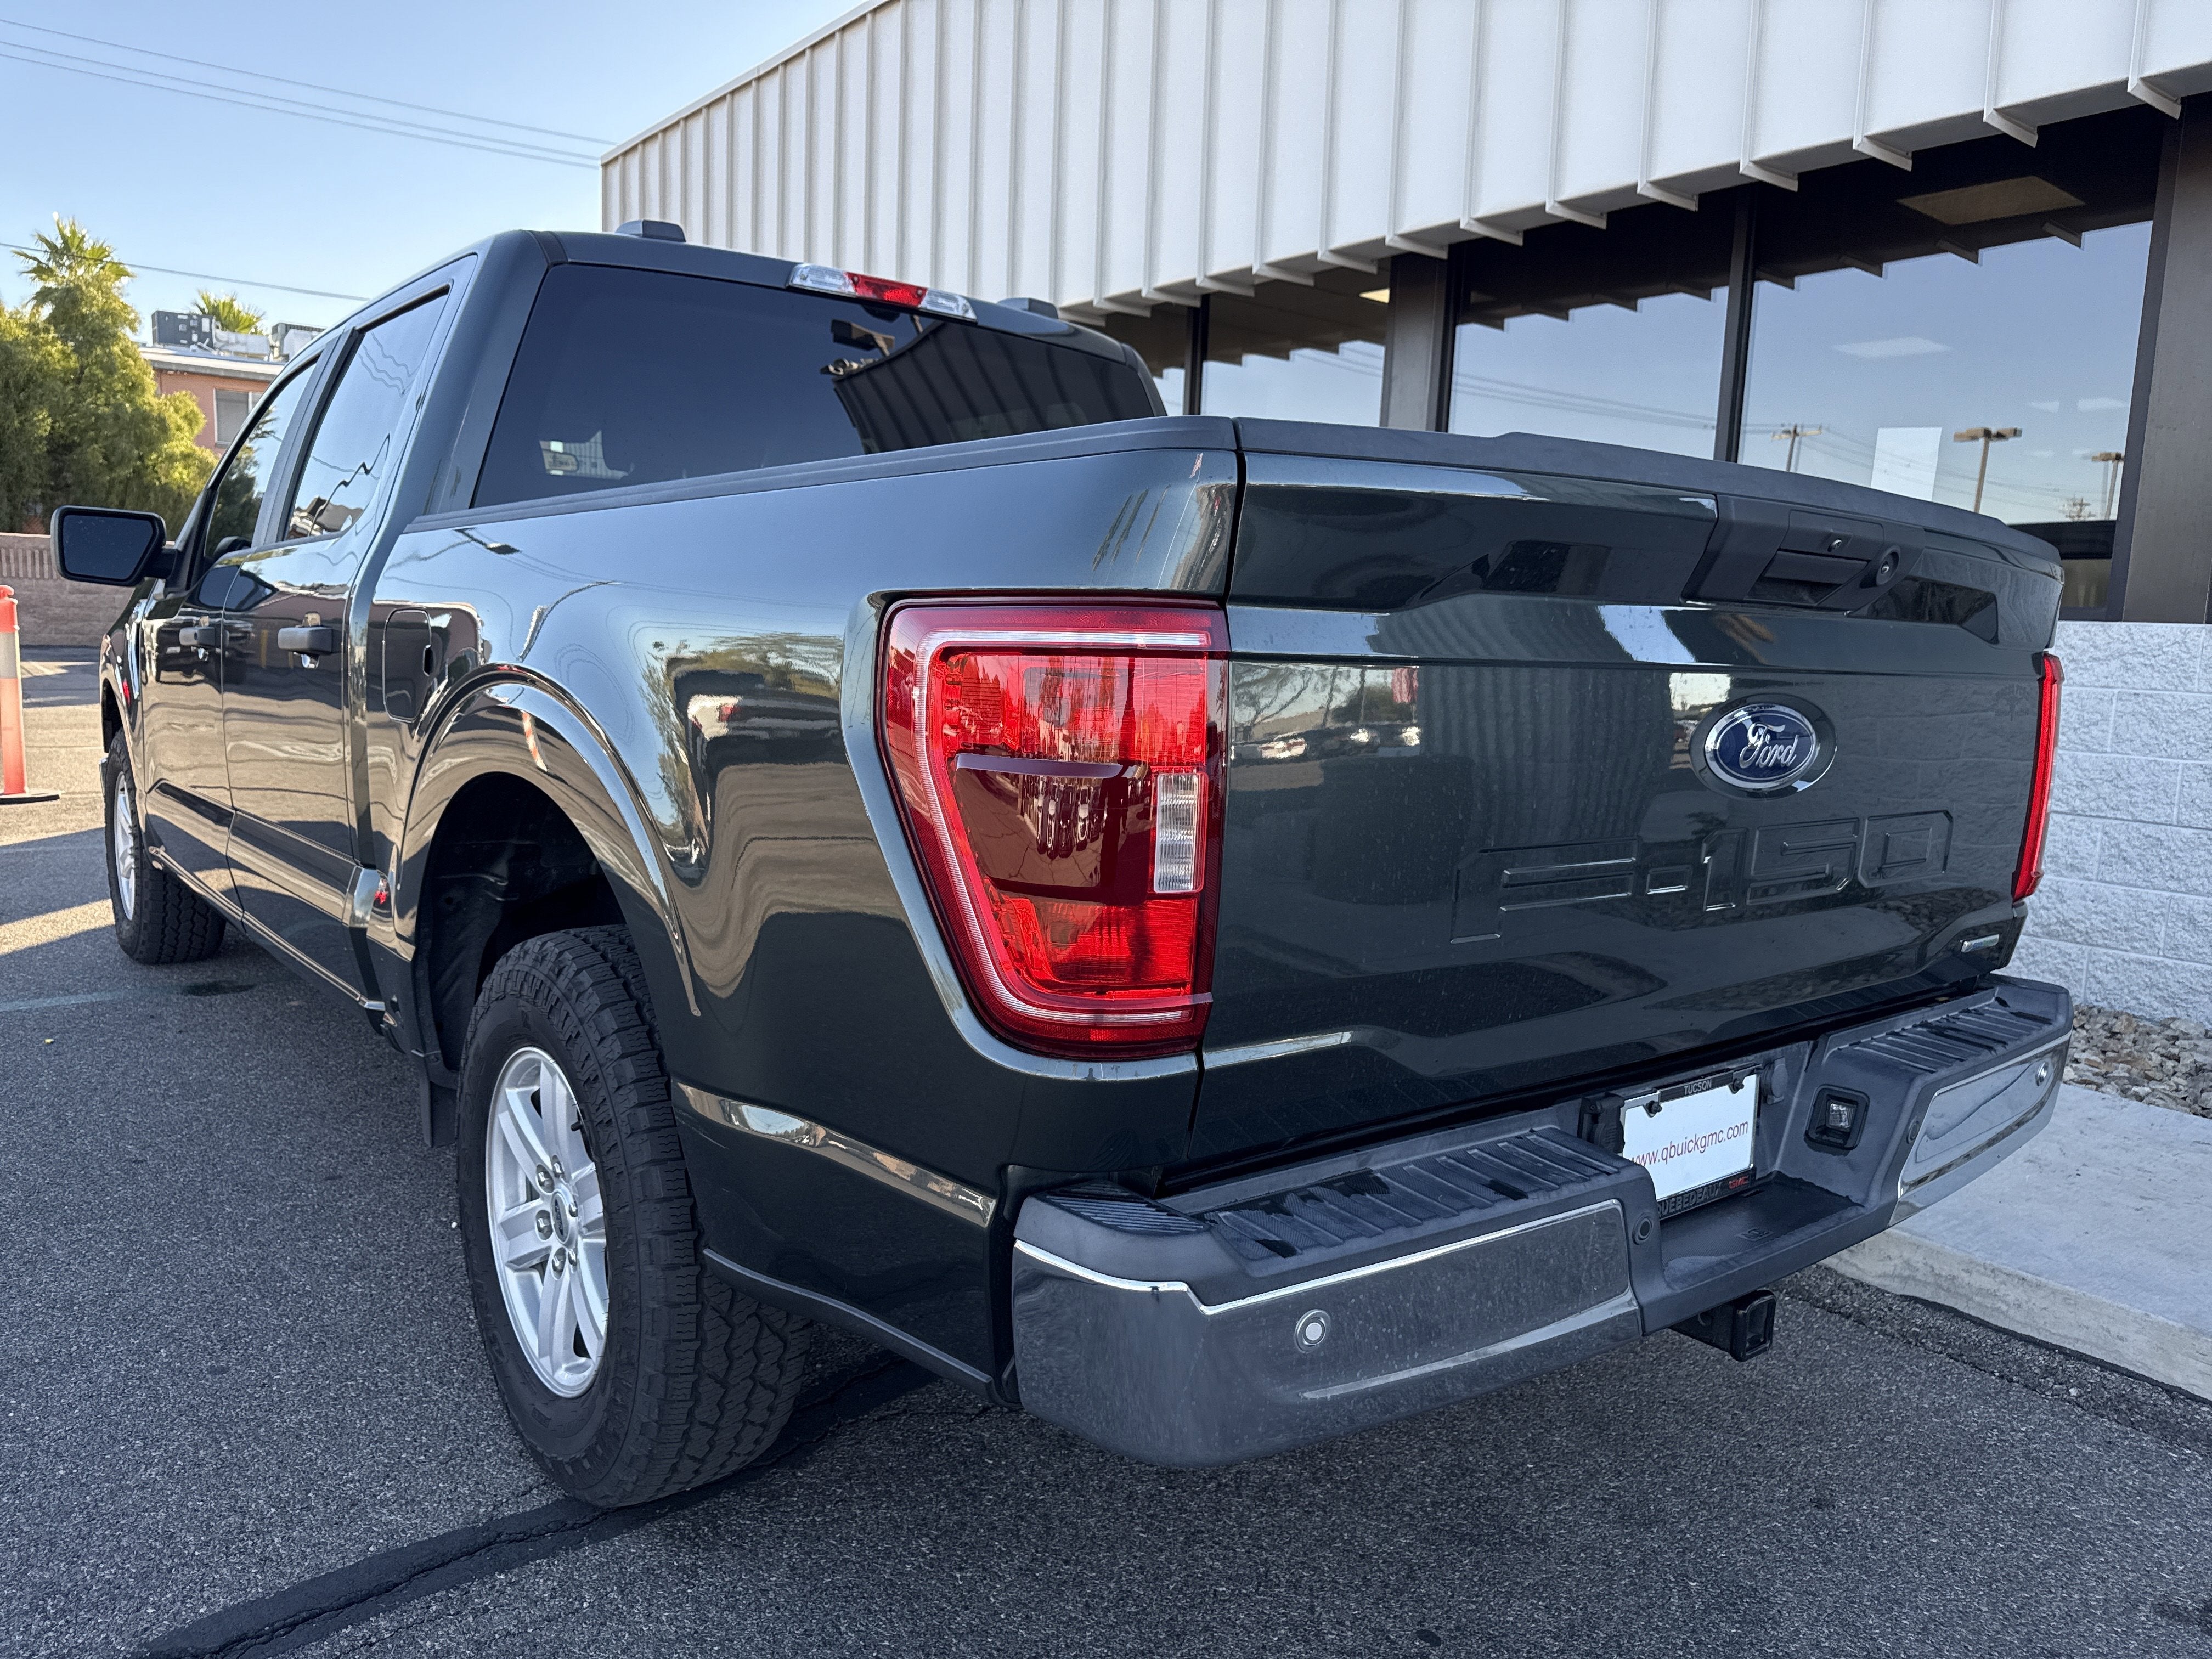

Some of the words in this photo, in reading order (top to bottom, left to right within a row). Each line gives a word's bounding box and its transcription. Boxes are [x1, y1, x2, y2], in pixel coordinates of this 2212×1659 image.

[1739, 723, 1799, 768] Ford
[1450, 810, 1953, 944] F-150
[1684, 1079, 1712, 1096] TUCSON
[1729, 1176, 1749, 1189] GMC
